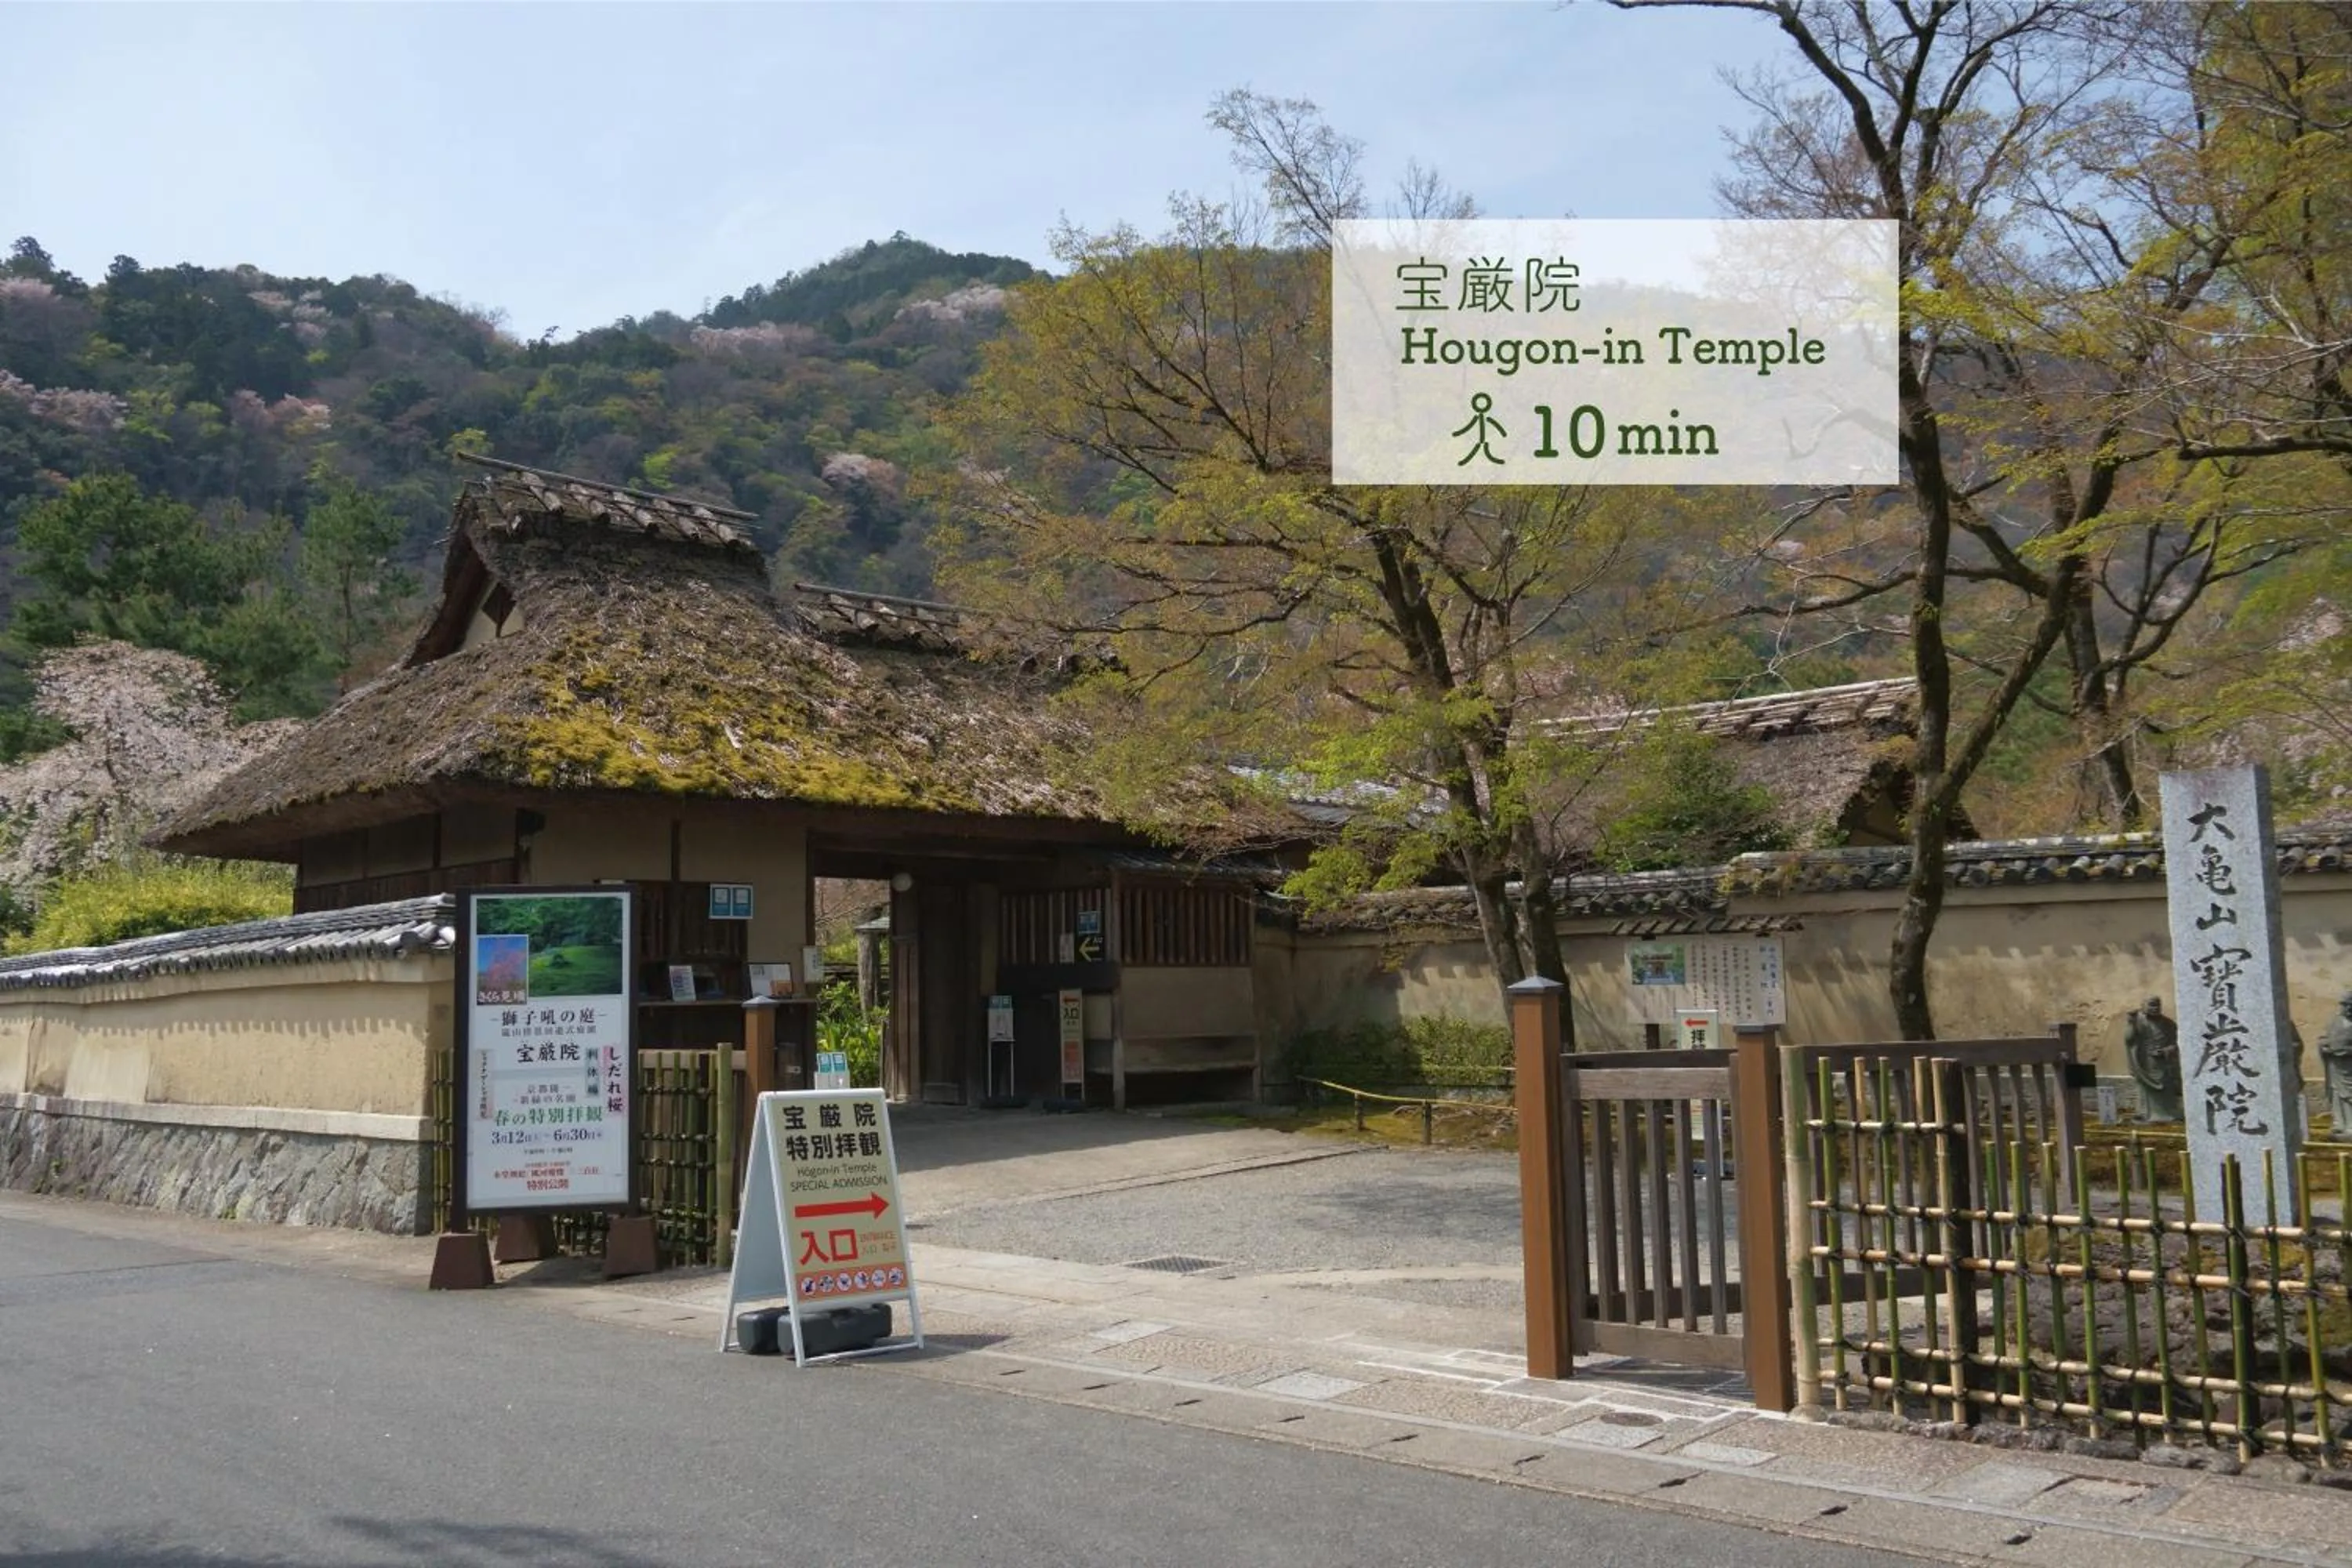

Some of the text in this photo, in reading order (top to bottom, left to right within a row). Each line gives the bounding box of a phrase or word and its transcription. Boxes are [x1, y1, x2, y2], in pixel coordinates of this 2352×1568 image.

[517, 1043, 581, 1063] 宝厳院
[607, 1046, 624, 1112] しだれ桜
[495, 1106, 604, 1127] 春の特別拝観
[782, 1102, 877, 1130] 宝厳院
[786, 1131, 882, 1161] 特別拝観
[842, 1161, 878, 1174] Temple
[789, 1175, 888, 1192] SPECIAL ADMISSION
[800, 1229, 858, 1266] 入口
